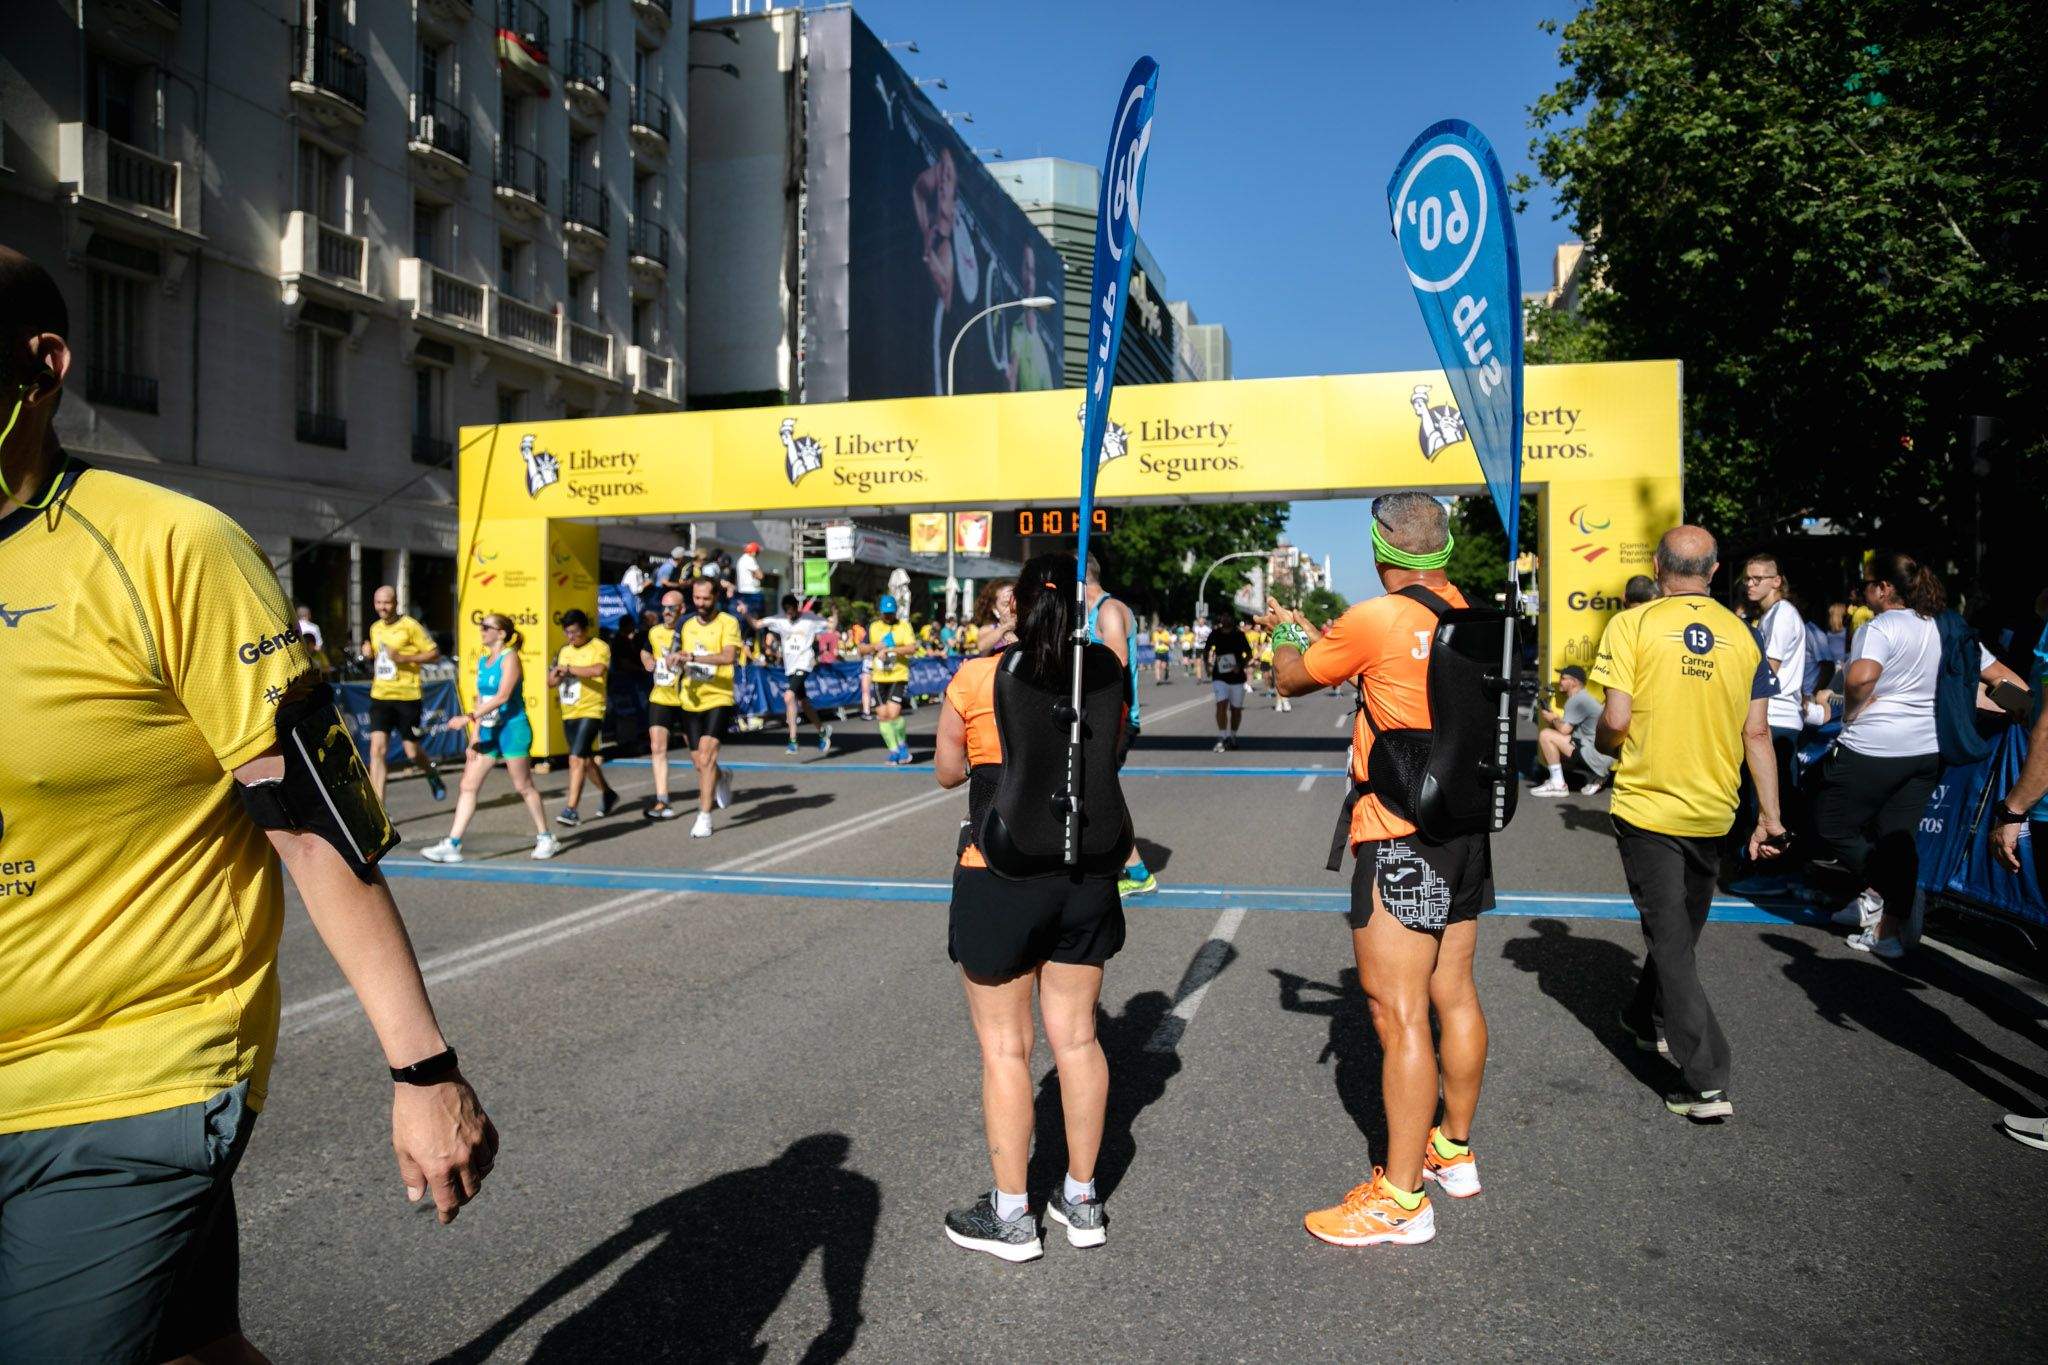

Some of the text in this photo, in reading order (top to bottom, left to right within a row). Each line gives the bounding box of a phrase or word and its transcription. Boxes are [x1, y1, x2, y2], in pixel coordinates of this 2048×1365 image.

[1140, 418, 1233, 448] Liberty
[1524, 405, 1581, 435] erty
[568, 449, 640, 475] Liberty
[834, 433, 919, 462] Liberty
[1689, 629, 1708, 648] 13
